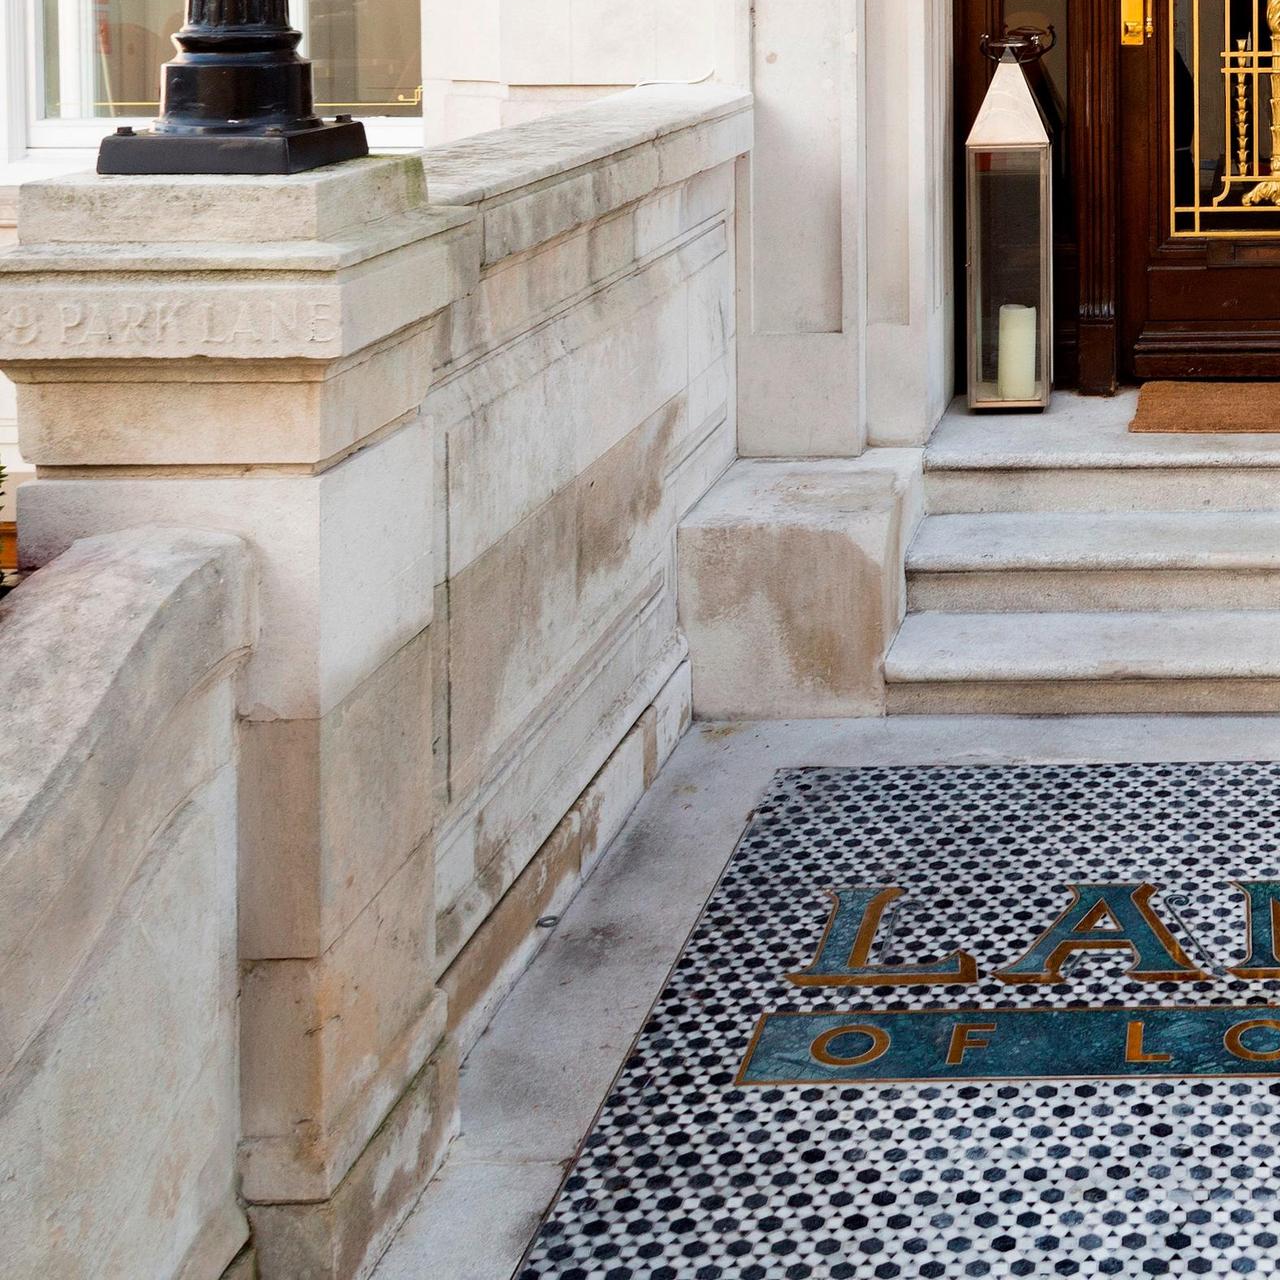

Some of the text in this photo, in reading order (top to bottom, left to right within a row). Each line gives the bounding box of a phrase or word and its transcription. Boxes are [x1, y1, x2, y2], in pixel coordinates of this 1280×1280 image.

[56, 302, 188, 345] PARK
[200, 301, 338, 344] LANE
[808, 1021, 997, 1067] OF
